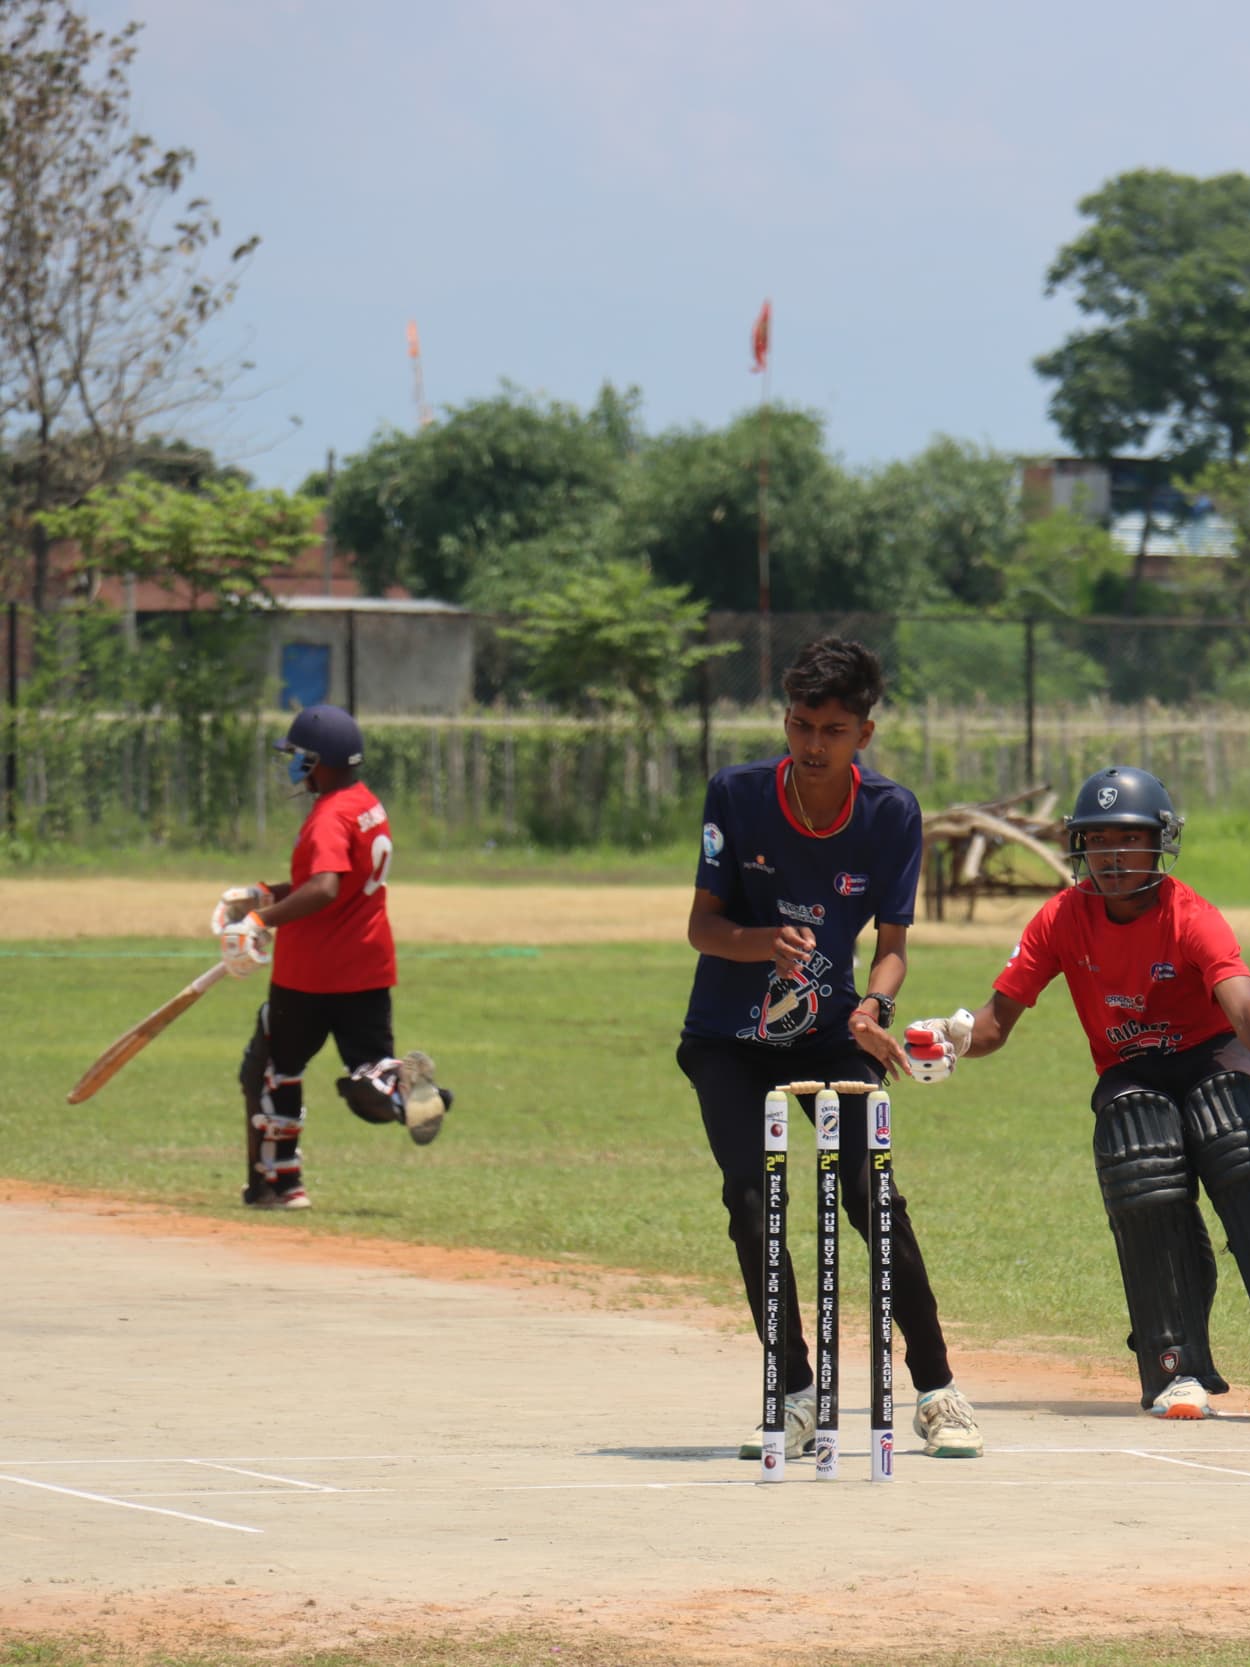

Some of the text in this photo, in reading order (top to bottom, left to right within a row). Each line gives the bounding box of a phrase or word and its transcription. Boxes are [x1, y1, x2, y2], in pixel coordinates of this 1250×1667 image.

[770, 1174, 781, 1207] NEPAL
[825, 1173, 836, 1206] NEPAL
[880, 1173, 890, 1205] NEPAL
[769, 1214, 780, 1234] HUB
[825, 1213, 835, 1232] HUB
[881, 1212, 890, 1232] HUB
[769, 1240, 779, 1266] BOYS
[824, 1239, 834, 1265] BOYS
[881, 1238, 891, 1264] BOYS
[768, 1273, 778, 1292] T20
[824, 1272, 834, 1291] T20
[881, 1271, 891, 1291] T20
[768, 1298, 778, 1344] CRICKET
[823, 1298, 833, 1343] CRICKET
[882, 1297, 892, 1342] CRICKET
[767, 1352, 777, 1390] LEAGUE
[822, 1350, 832, 1389] LEAGUE
[883, 1350, 892, 1388] LEAGUE
